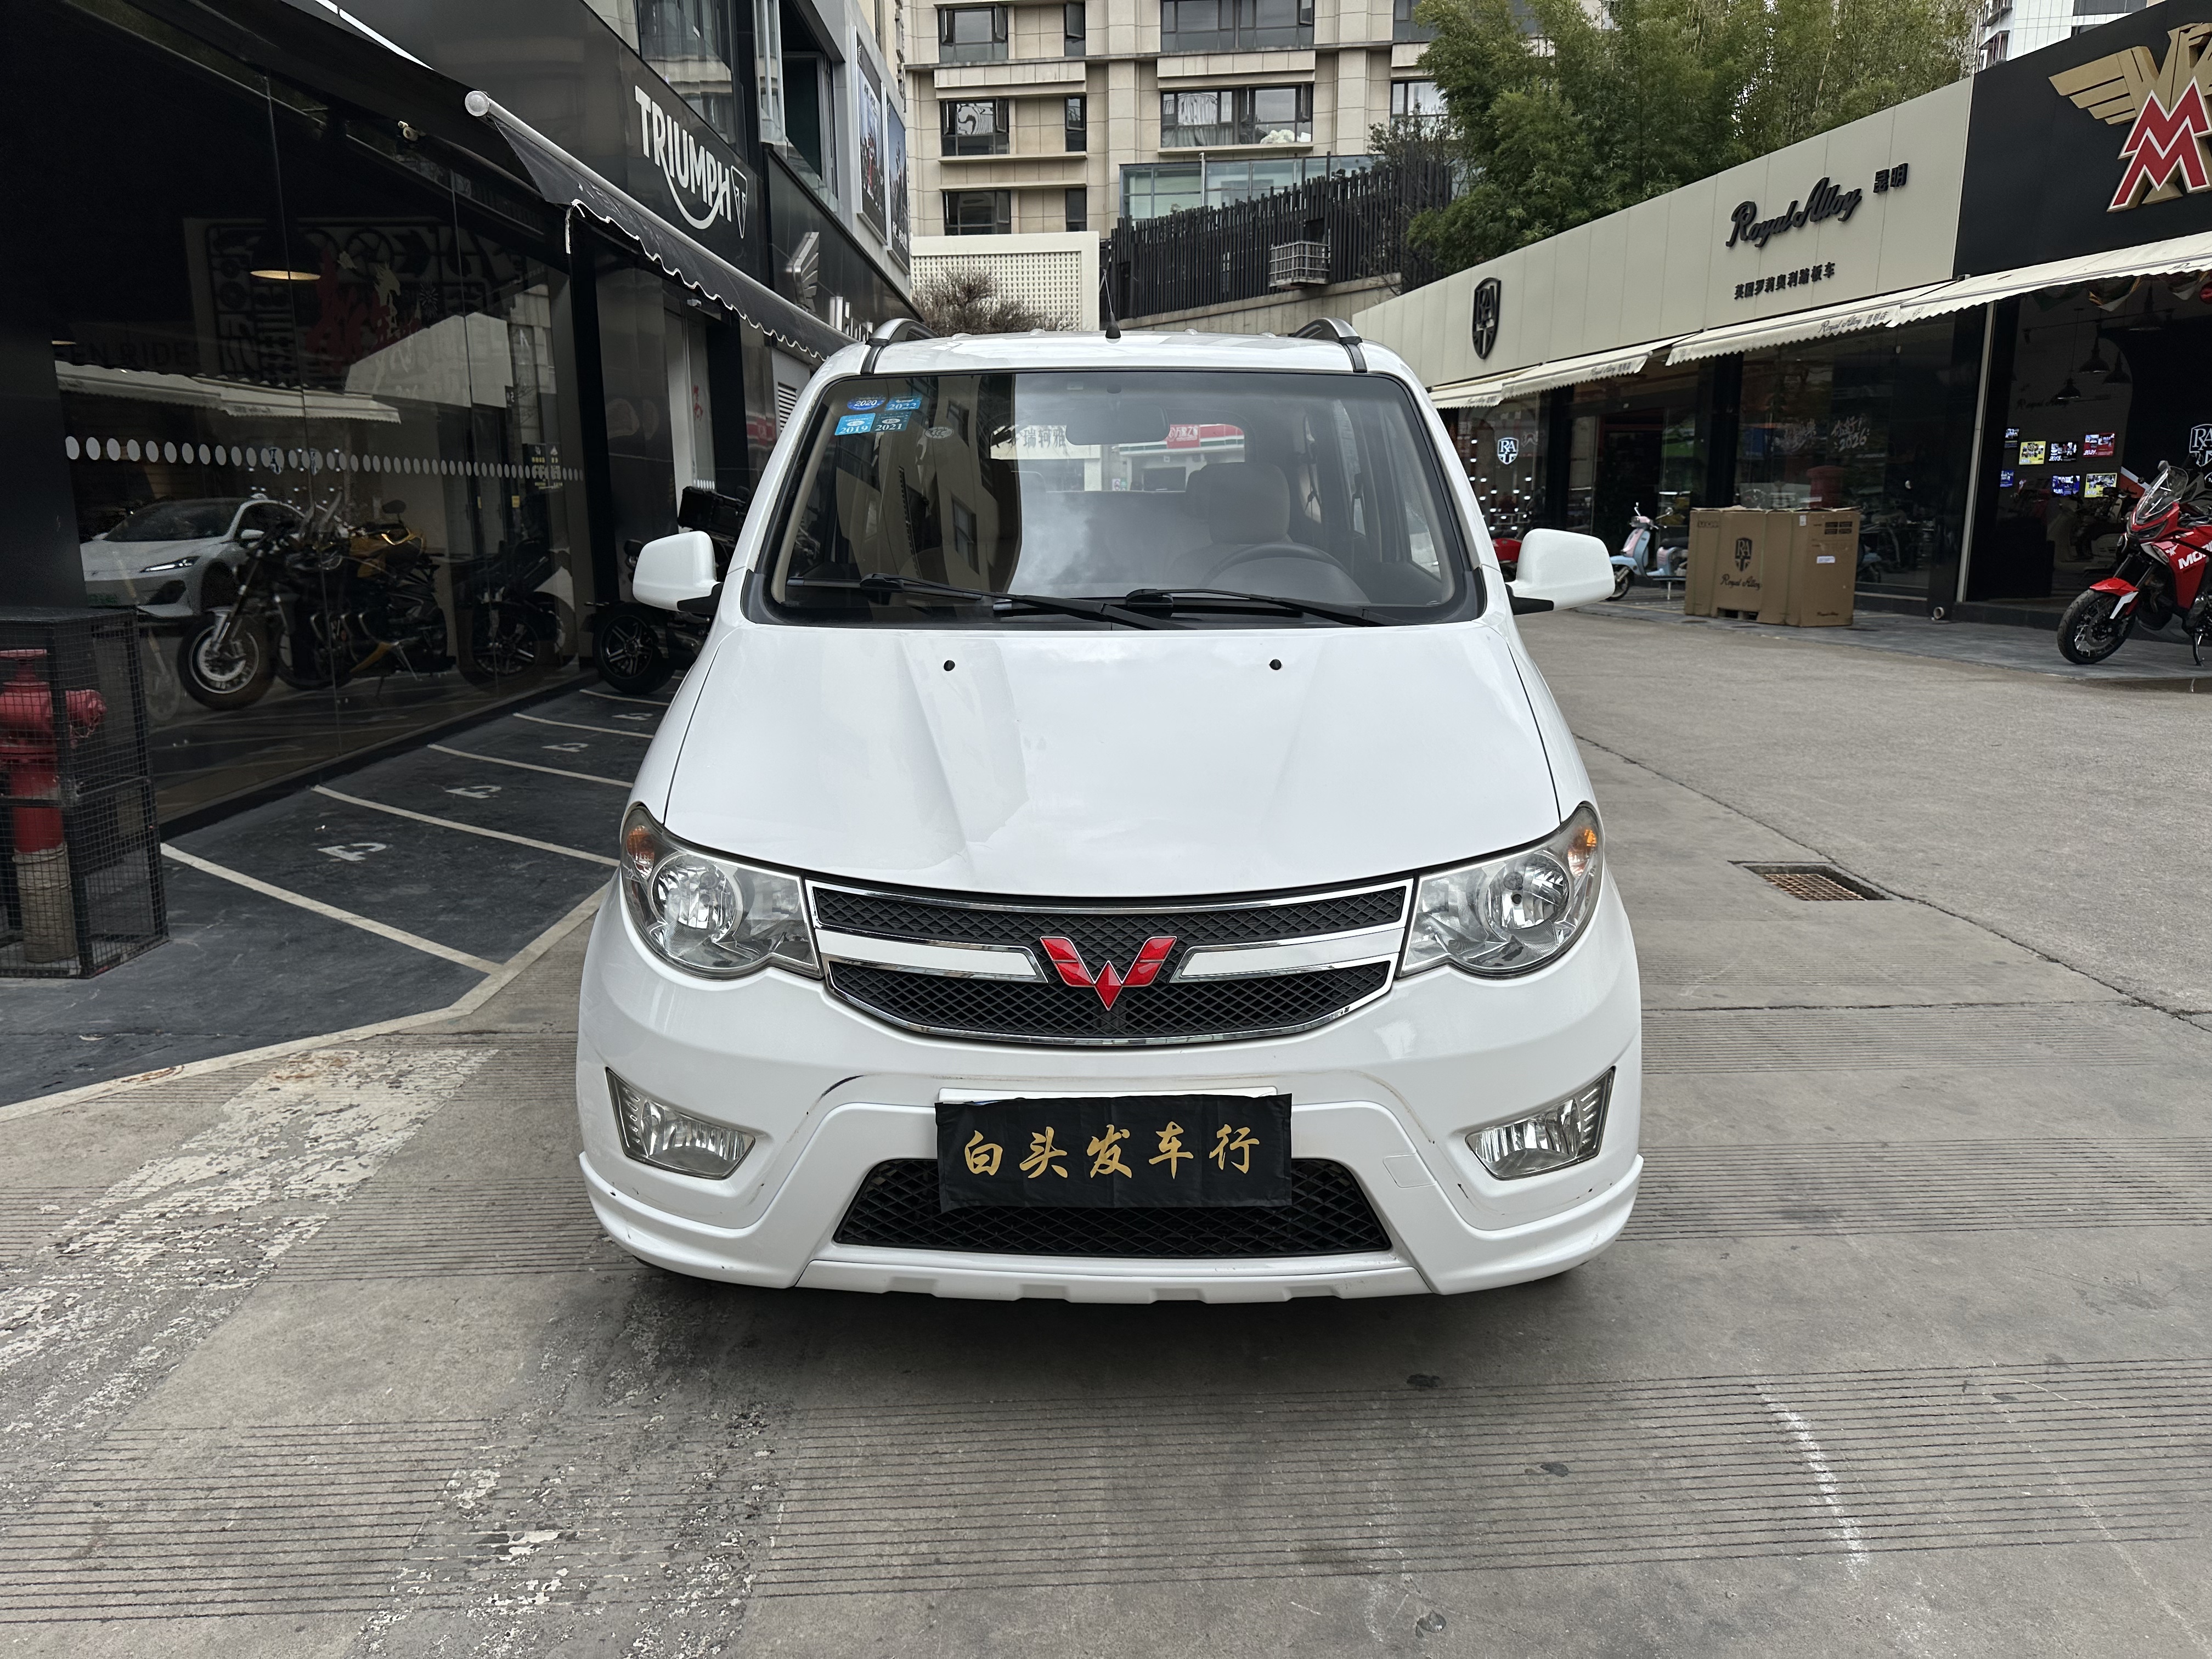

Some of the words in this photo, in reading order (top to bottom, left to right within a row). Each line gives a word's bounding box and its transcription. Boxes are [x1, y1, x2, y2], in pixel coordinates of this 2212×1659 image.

[635, 85, 732, 229] TRIUMPH
[1872, 162, 1909, 193] 昆明
[1725, 200, 1798, 247] Royal
[1792, 177, 1863, 228] Alloy
[888, 402, 917, 410] 2022
[839, 425, 868, 434] 2019
[874, 423, 902, 432] 2021
[1500, 440, 1516, 454] RA
[1838, 427, 1867, 453] 2026
[1737, 539, 1752, 557] RA
[1720, 573, 1741, 590] Royal
[1742, 575, 1763, 591] Alloy
[963, 1120, 1260, 1180] 白头发车行
